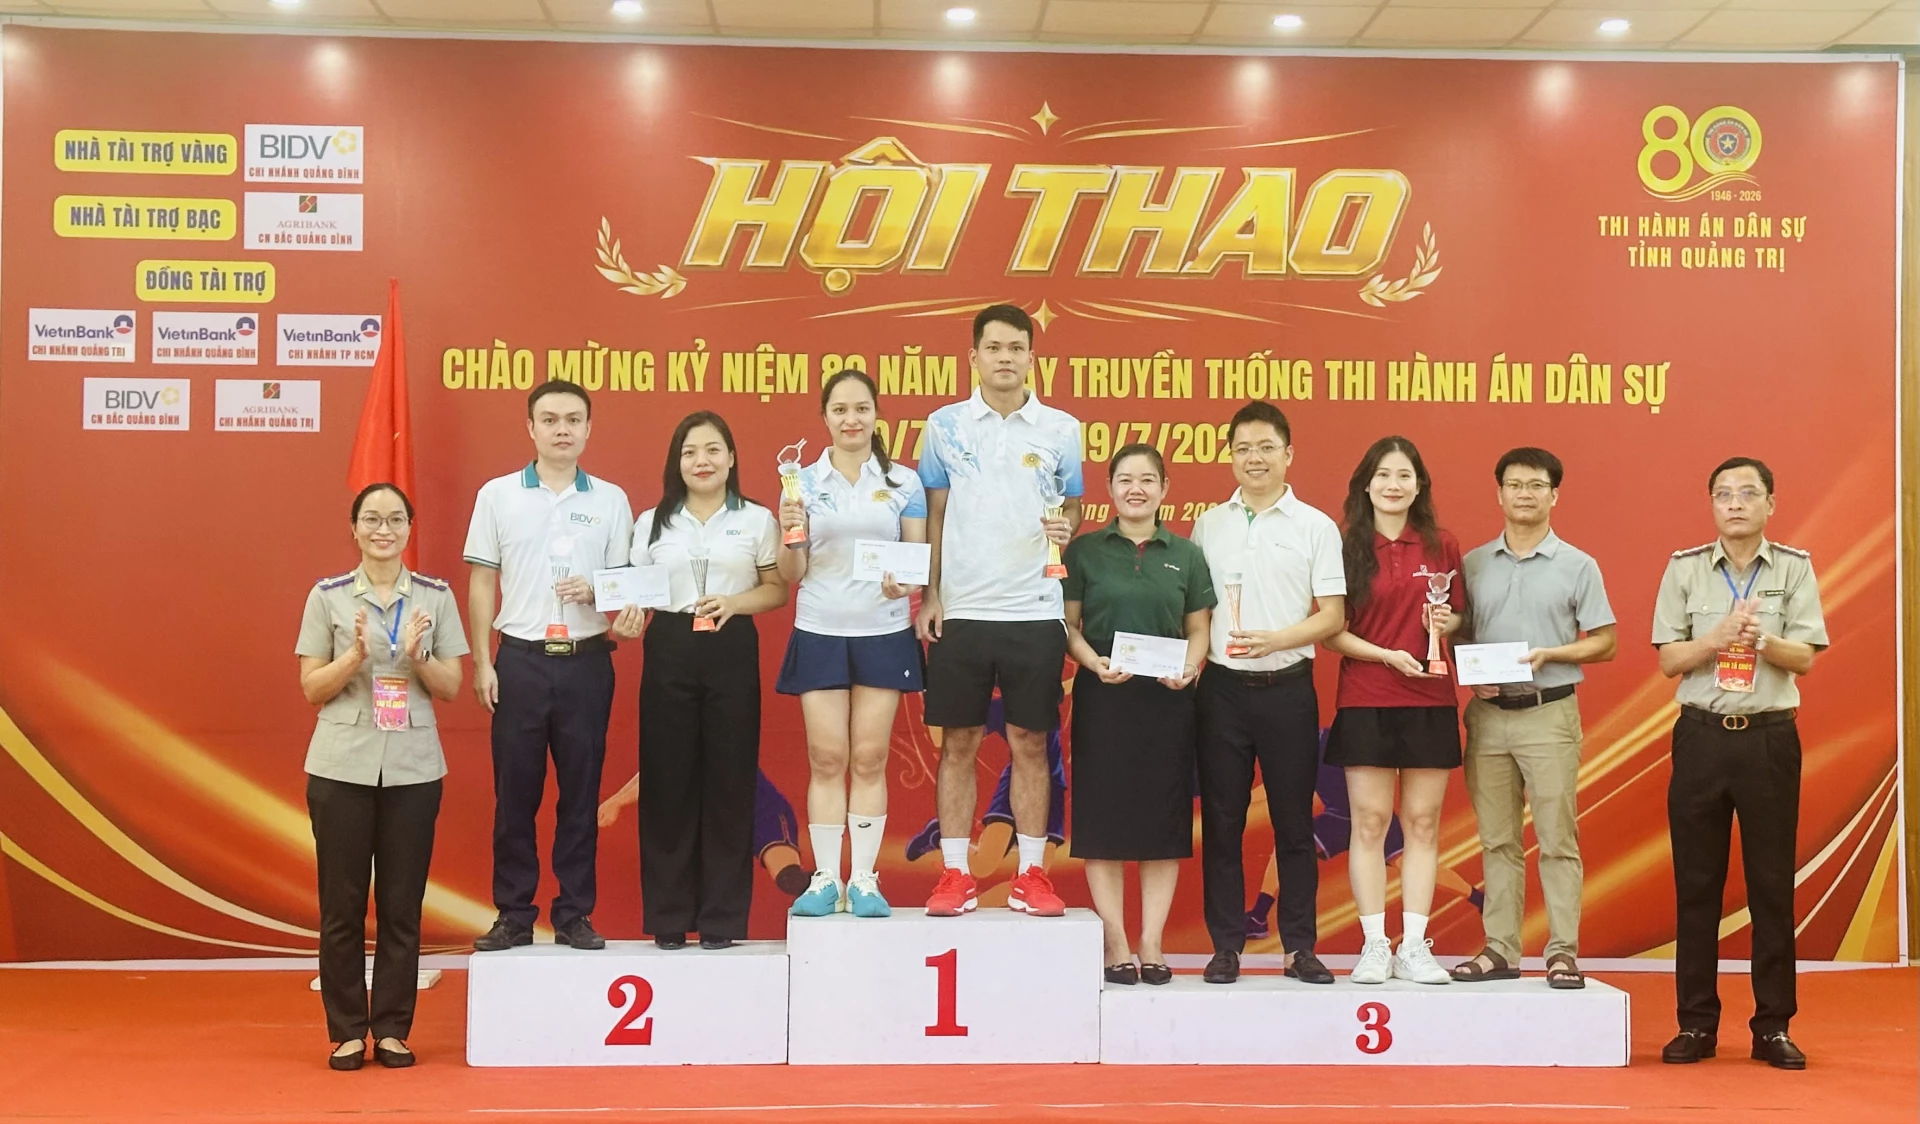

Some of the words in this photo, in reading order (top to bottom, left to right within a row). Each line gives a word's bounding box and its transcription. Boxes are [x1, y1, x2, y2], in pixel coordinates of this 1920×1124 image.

[65, 136, 100, 160] NHÀ
[108, 137, 134, 161] TÀI
[141, 141, 174, 167] TRỢ
[181, 139, 228, 164] VÀNG
[260, 134, 332, 159] BIDV
[1638, 105, 1762, 193] 80
[249, 167, 264, 177] CHI
[268, 166, 299, 178] NHÁNH
[303, 165, 334, 178] QUẢNG
[338, 167, 359, 179] BÌNH
[1710, 190, 1732, 201] 1946
[1739, 190, 1762, 201] 2026
[70, 203, 105, 226] NHÀ
[113, 203, 140, 227] TÀI
[147, 207, 180, 232] TRỢ
[186, 209, 221, 233] BẠC
[684, 136, 992, 294] HỘI
[1004, 164, 1412, 280] THAO
[277, 220, 337, 229] AGRIBANK
[1598, 216, 1629, 237] THI
[1638, 212, 1689, 238] HÀNH
[1699, 212, 1724, 238] ÁN
[1734, 212, 1772, 238] DÂN
[1781, 216, 1807, 242] SỰ
[258, 233, 270, 243] CN
[296, 231, 327, 245] QUẢNG
[331, 232, 352, 245] BÌNH
[1628, 240, 1671, 268] TỈNH
[1681, 241, 1746, 269] QUẢNG
[1755, 247, 1785, 272] TRỊ
[146, 266, 193, 291] ĐỒNG
[200, 268, 227, 291] TÀI
[233, 270, 266, 296] TRỢ
[34, 324, 114, 339] VietinBank
[158, 326, 236, 341] VietinBank
[283, 328, 361, 343] VietinBank
[32, 345, 46, 355] CHI
[49, 344, 78, 356] NHÁNH
[81, 344, 109, 357] QUẢNG
[156, 347, 171, 358] CHI
[174, 346, 202, 358] NHÁNH
[205, 345, 233, 359] QUẢNG
[236, 347, 256, 359] BÌNH
[288, 349, 303, 359] CHI
[307, 347, 337, 360] NHÁNH
[340, 349, 351, 359] TP
[354, 349, 375, 360] HCM
[443, 339, 534, 390] CHÀO
[547, 340, 654, 392] MỪNG
[668, 338, 710, 393] KỶ
[722, 343, 808, 403] NIỆM
[879, 345, 957, 396] NĂM
[1069, 349, 1191, 400] TRUYỀN
[1206, 349, 1312, 402] THỐNG
[1325, 359, 1376, 401] THI
[1388, 352, 1476, 403] HÀNH
[1489, 353, 1532, 404] ÁN
[1545, 353, 1610, 404] DÂN
[1623, 361, 1671, 413] SỰ
[105, 390, 160, 410] BIDV
[91, 414, 102, 424] CN
[126, 412, 156, 425] QUẢNG
[159, 413, 180, 425] BÌNH
[242, 406, 299, 414] AGRIBANK
[219, 417, 233, 427] CHI
[236, 415, 266, 428] NHÁNH
[268, 415, 298, 428] QUẢNG
[300, 418, 314, 430] TRỊ
[570, 512, 594, 524] BIDV
[923, 948, 969, 1037] 1
[604, 975, 654, 1046] 2
[1355, 1002, 1392, 1055] 3
